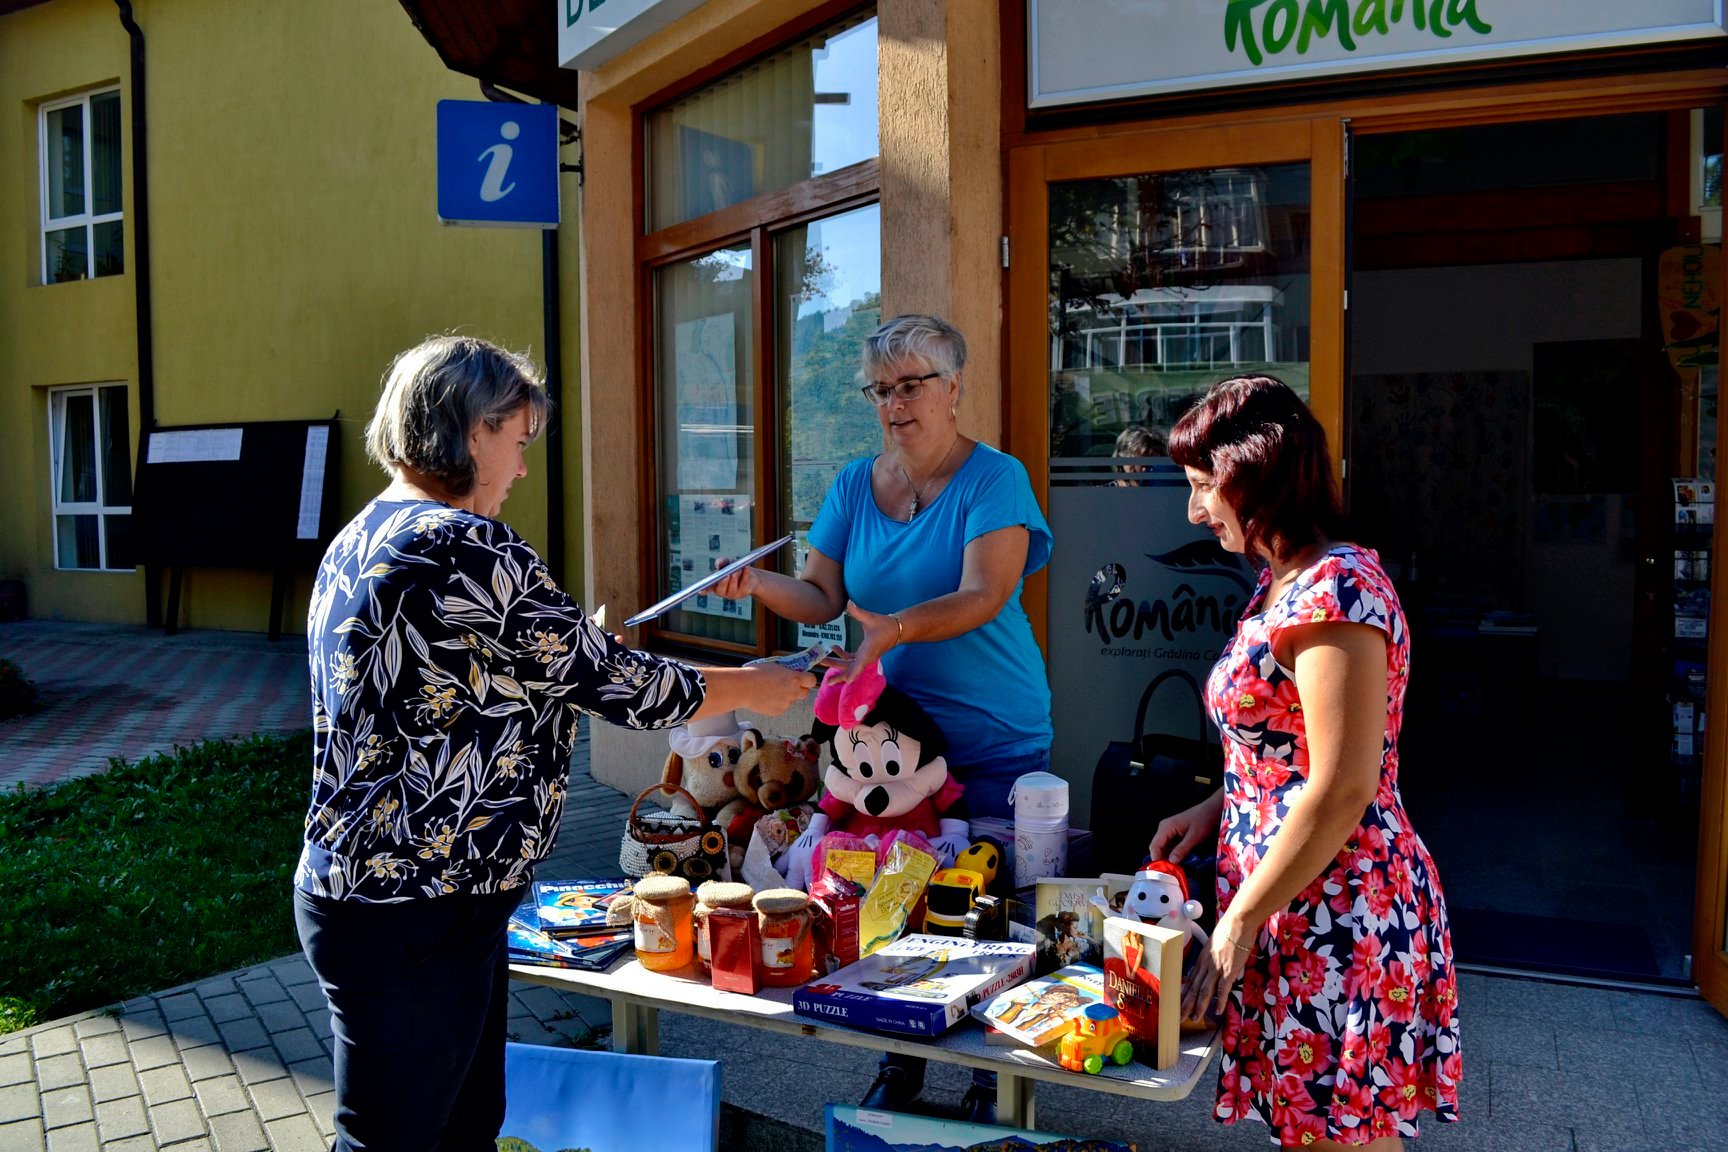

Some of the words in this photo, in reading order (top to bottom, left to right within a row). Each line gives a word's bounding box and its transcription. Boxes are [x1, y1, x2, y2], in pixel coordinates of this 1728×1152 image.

[1084, 562, 1246, 645] Români
[1108, 970, 1153, 1005] DANIELLE
[797, 1000, 810, 1011] 3D
[813, 1003, 849, 1018] PUZZLE
